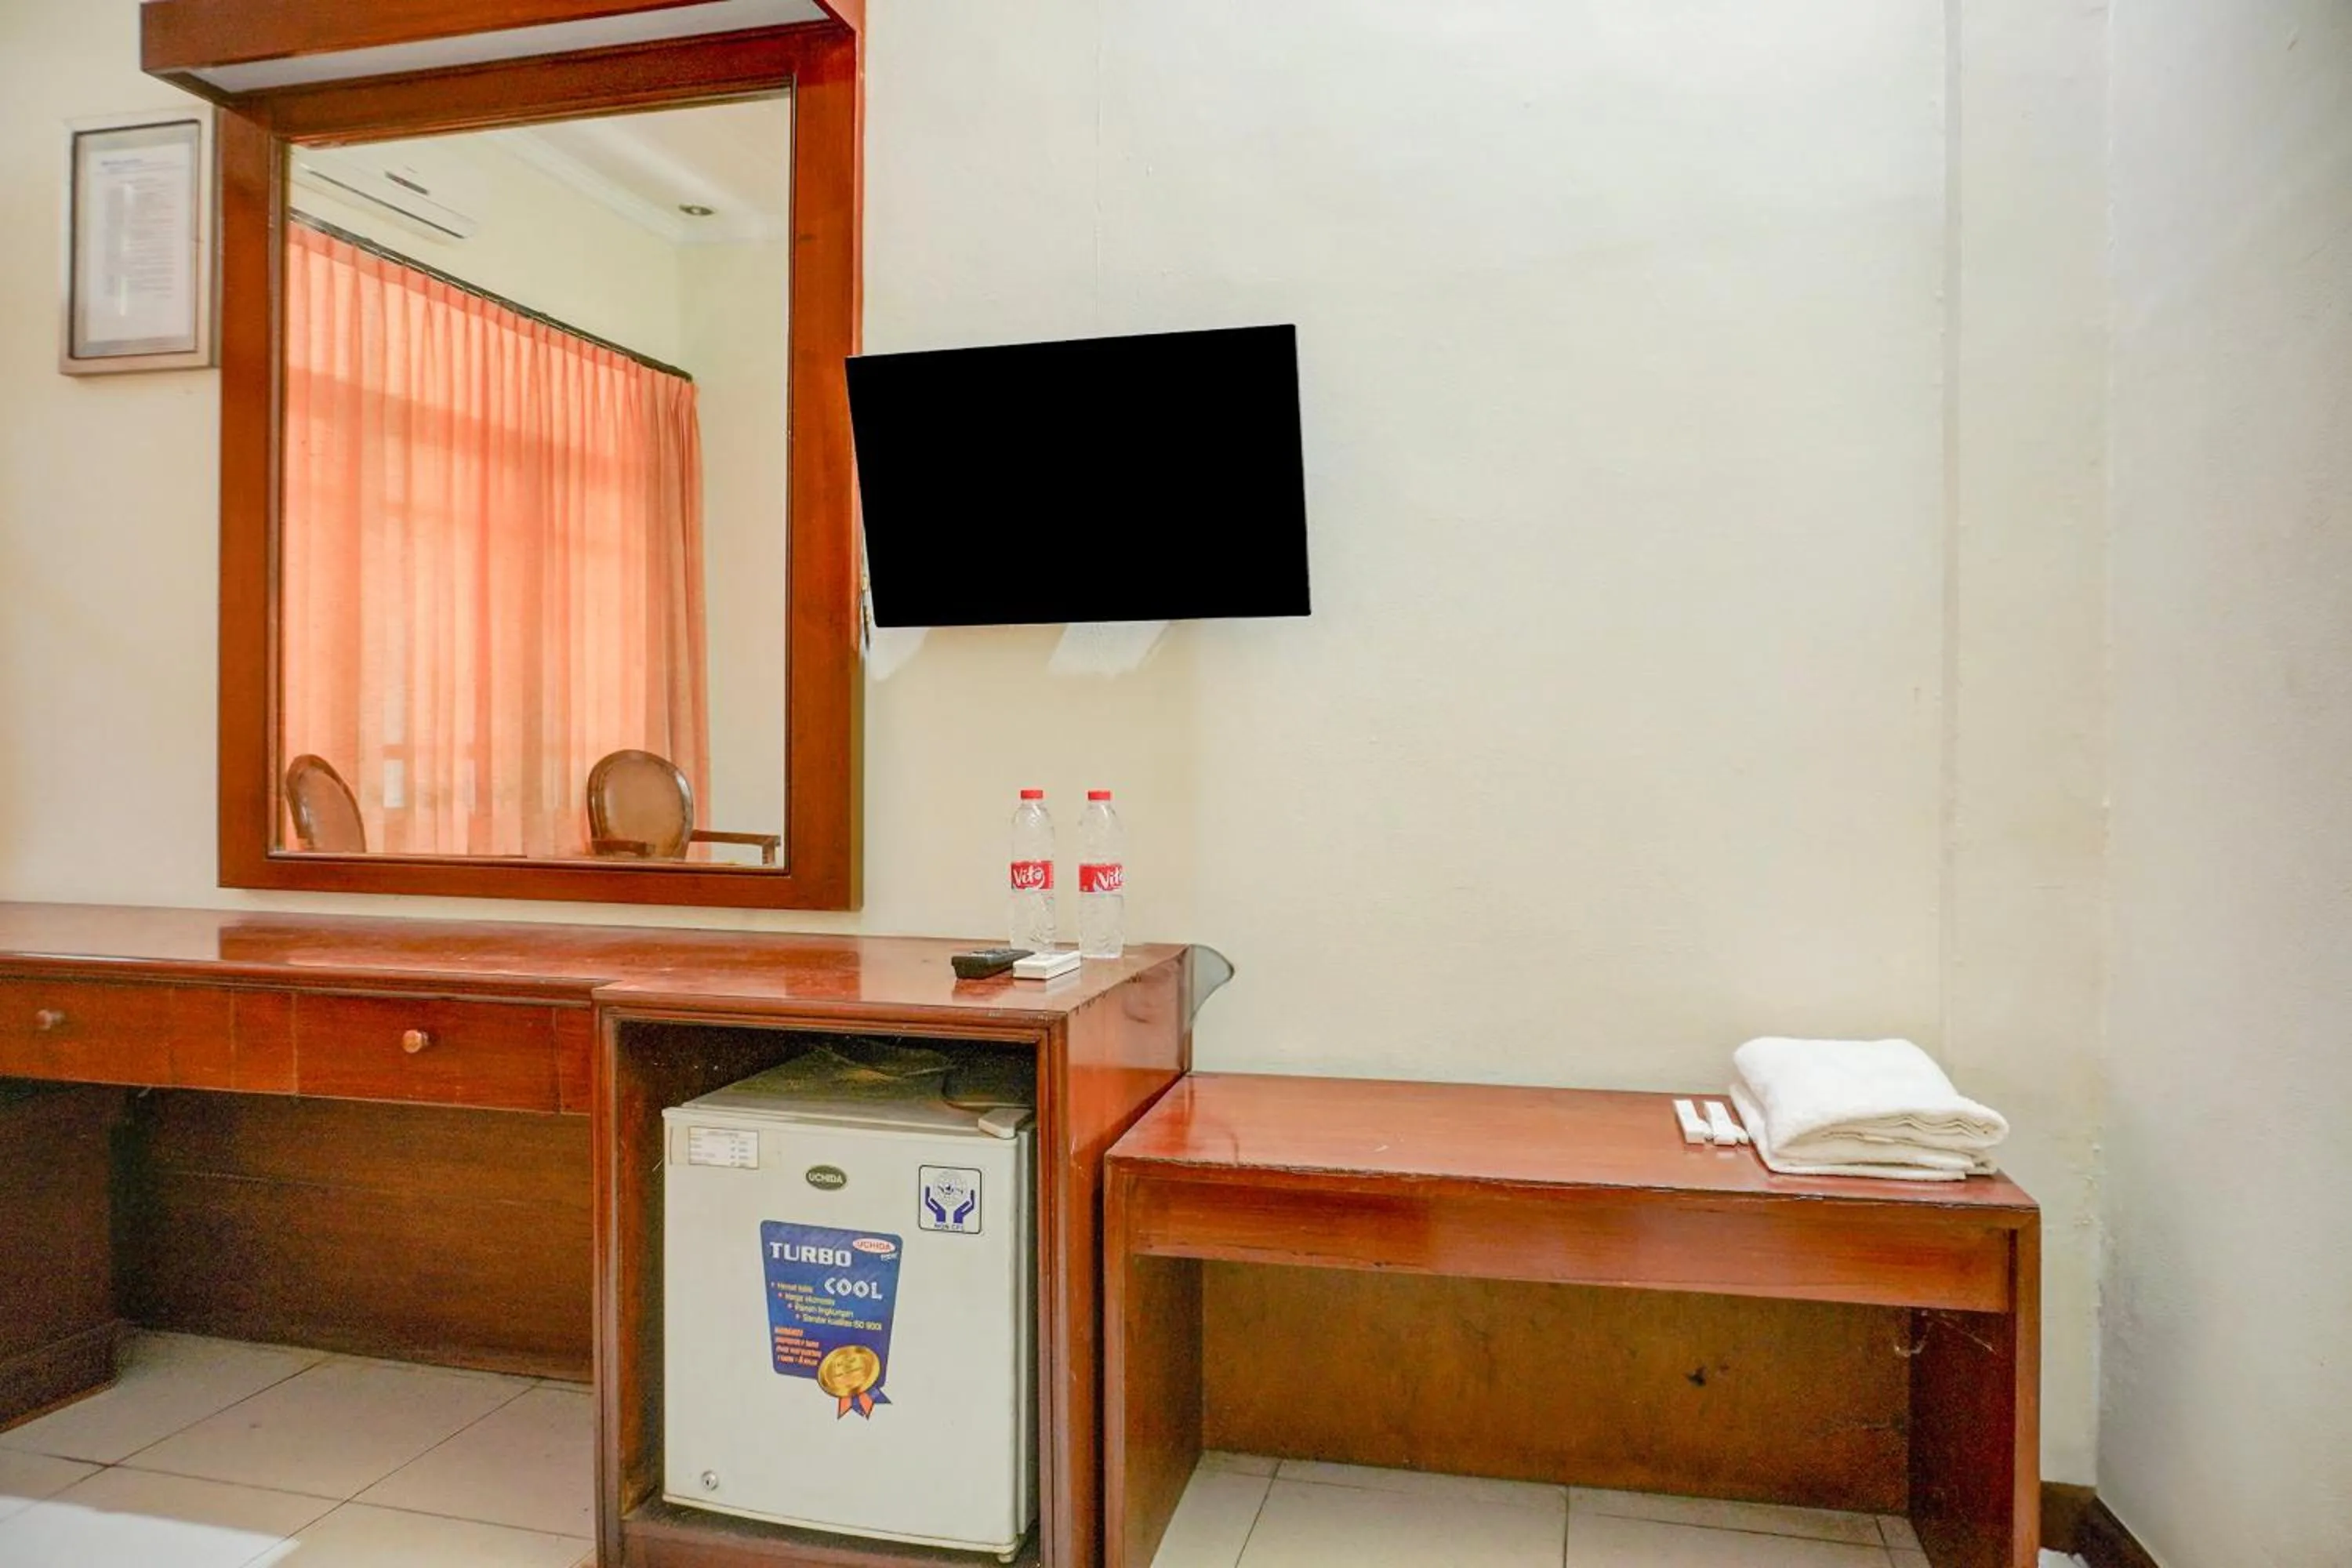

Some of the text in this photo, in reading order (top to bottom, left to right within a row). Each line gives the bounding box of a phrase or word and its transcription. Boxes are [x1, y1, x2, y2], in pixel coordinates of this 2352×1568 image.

[808, 1172, 843, 1184] UCHIDA
[770, 1241, 852, 1268] TURBO
[857, 1241, 892, 1251] UCHIDA
[824, 1277, 884, 1301] COOL
